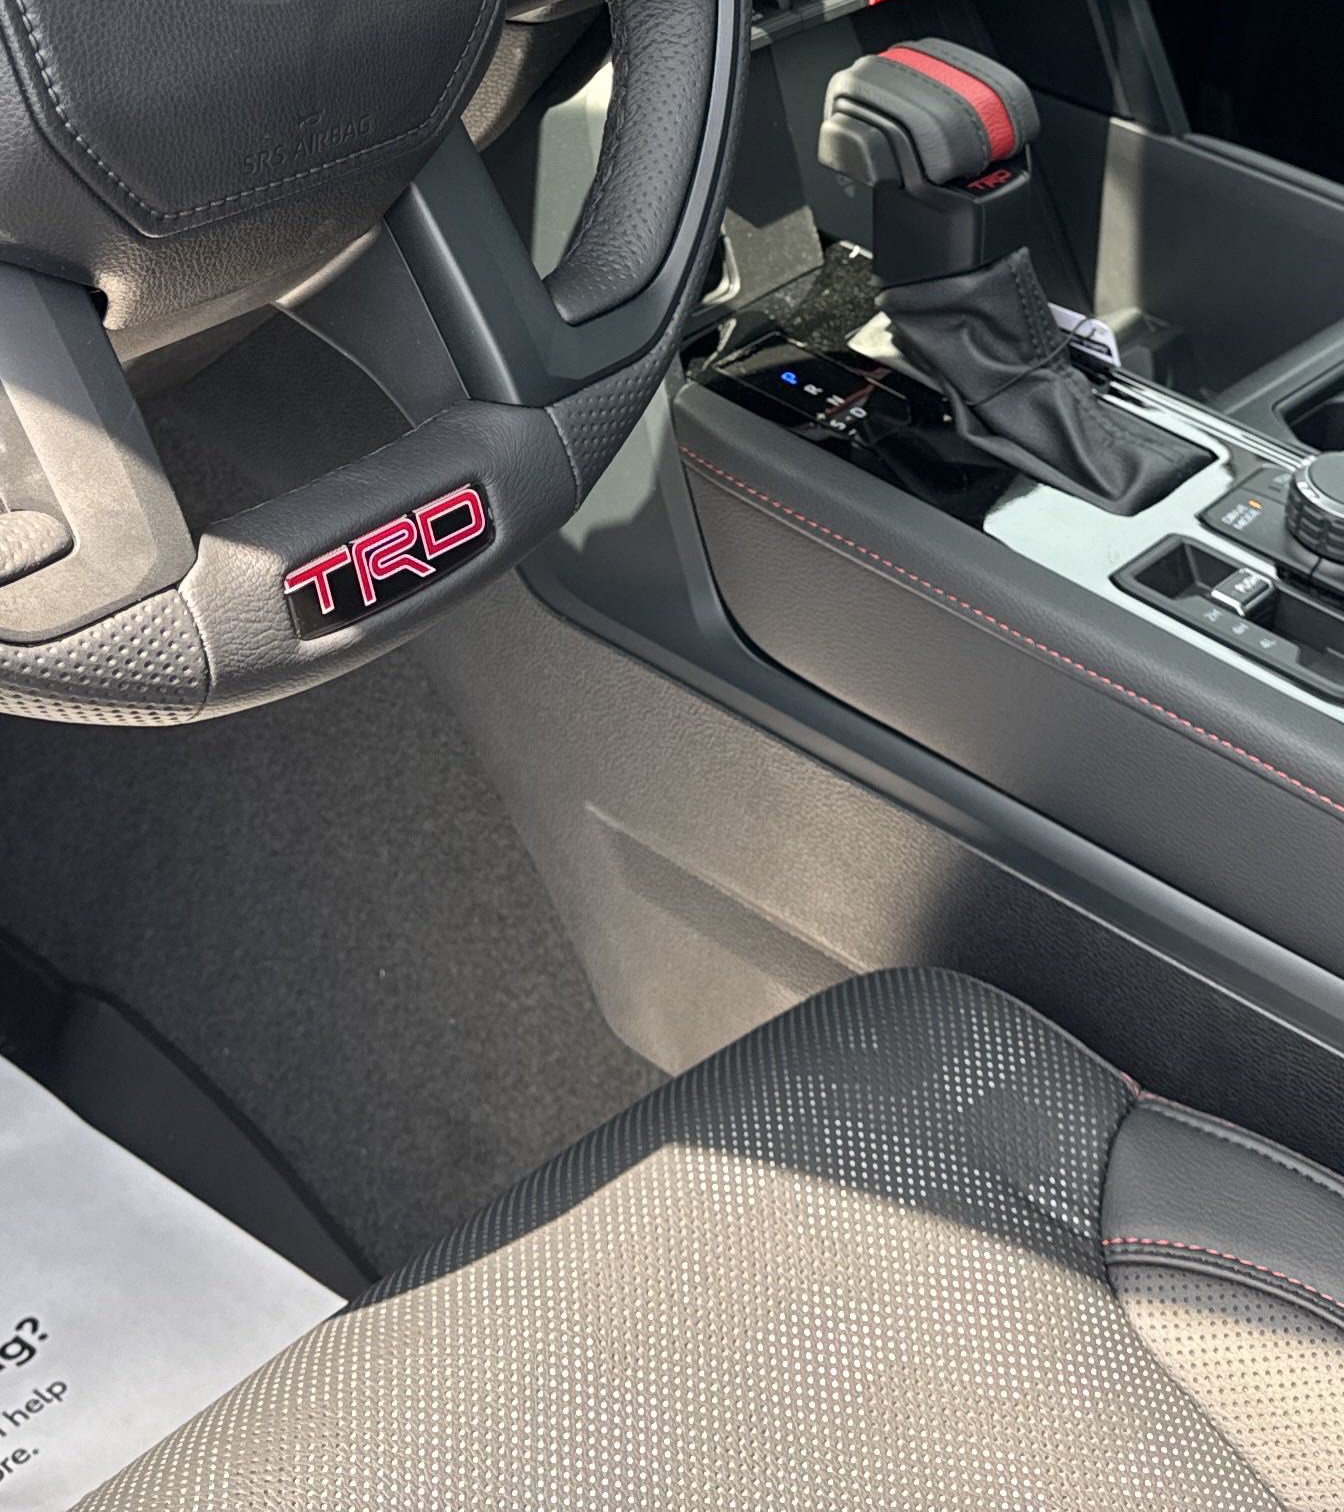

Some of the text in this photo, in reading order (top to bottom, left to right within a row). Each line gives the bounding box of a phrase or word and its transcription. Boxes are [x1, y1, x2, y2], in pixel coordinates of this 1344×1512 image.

[243, 113, 374, 177] SRS AIRBAG
[283, 483, 486, 615] TRD
[2, 1379, 69, 1429] help
